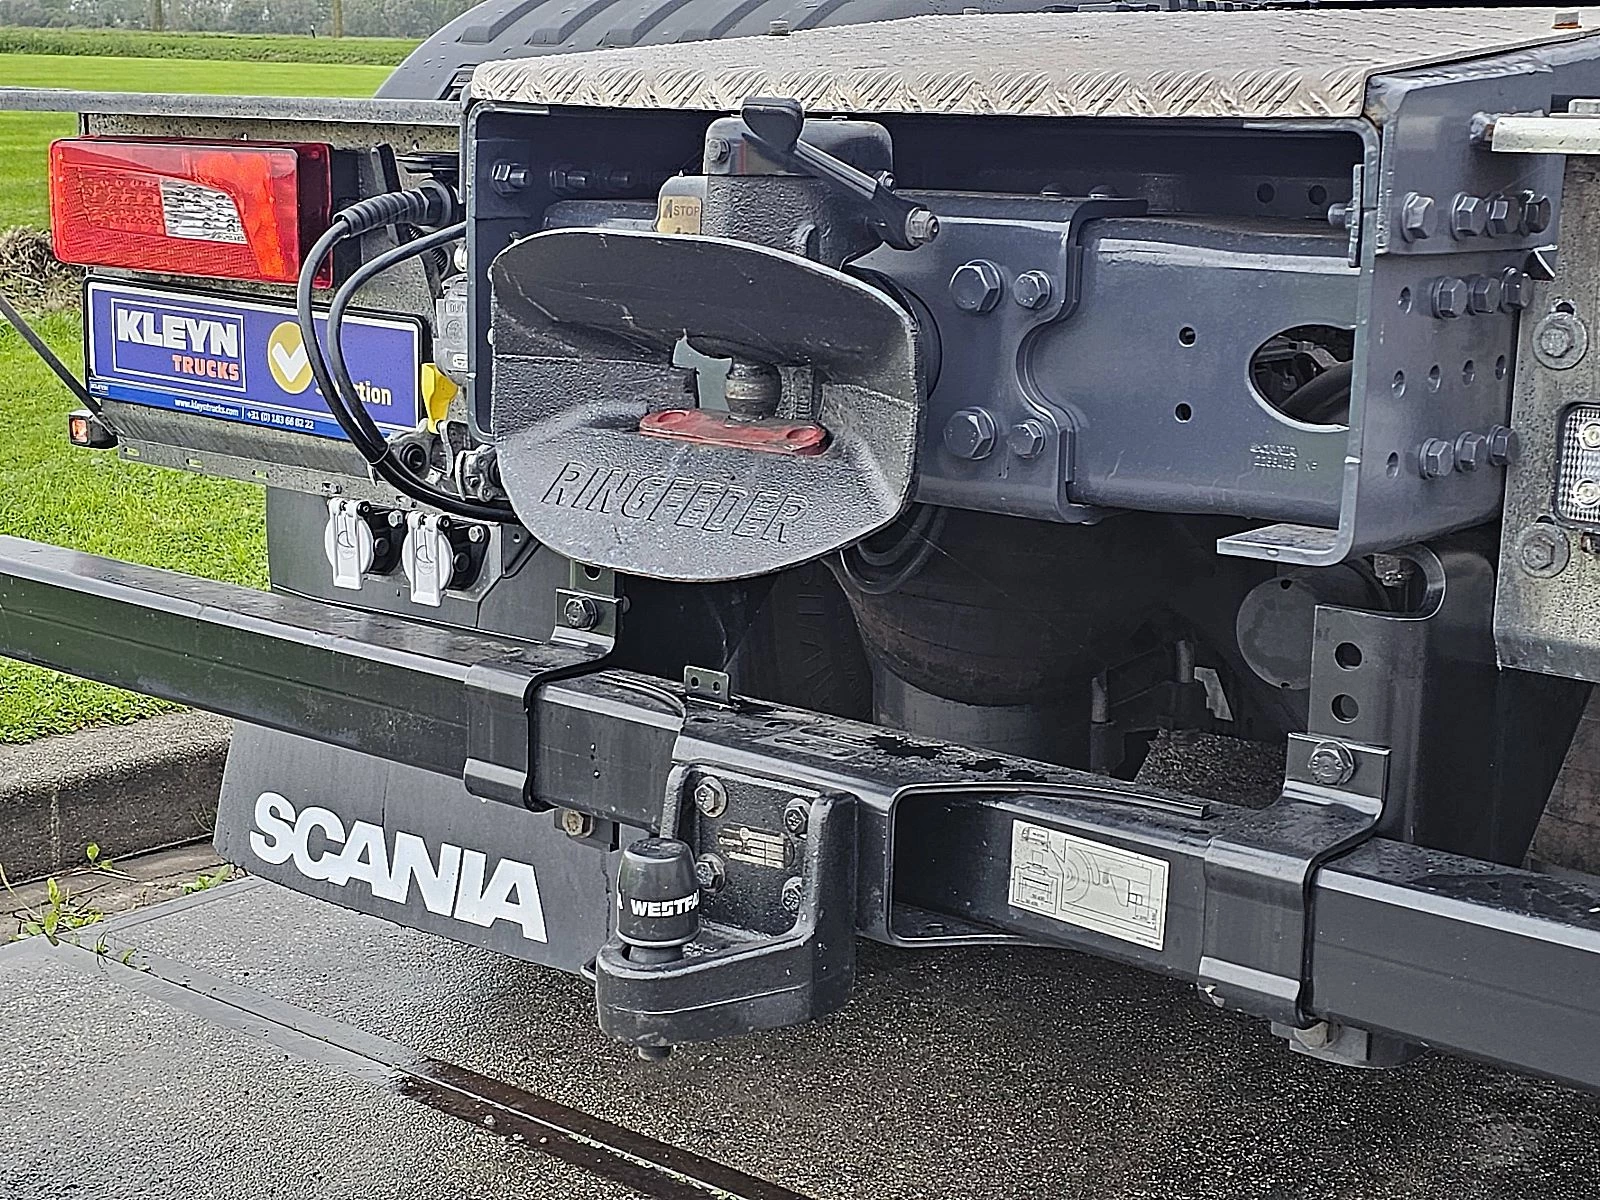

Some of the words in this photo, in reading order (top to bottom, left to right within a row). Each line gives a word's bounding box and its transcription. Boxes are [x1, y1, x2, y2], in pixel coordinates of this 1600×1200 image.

[673, 205, 700, 217] STOP
[117, 308, 239, 358] KLEYN
[172, 354, 240, 381] TRUCKS
[260, 411, 271, 422] (0)
[305, 419, 315, 430] 22
[541, 461, 811, 543] RINGFEDER
[249, 791, 548, 943] SCANIA
